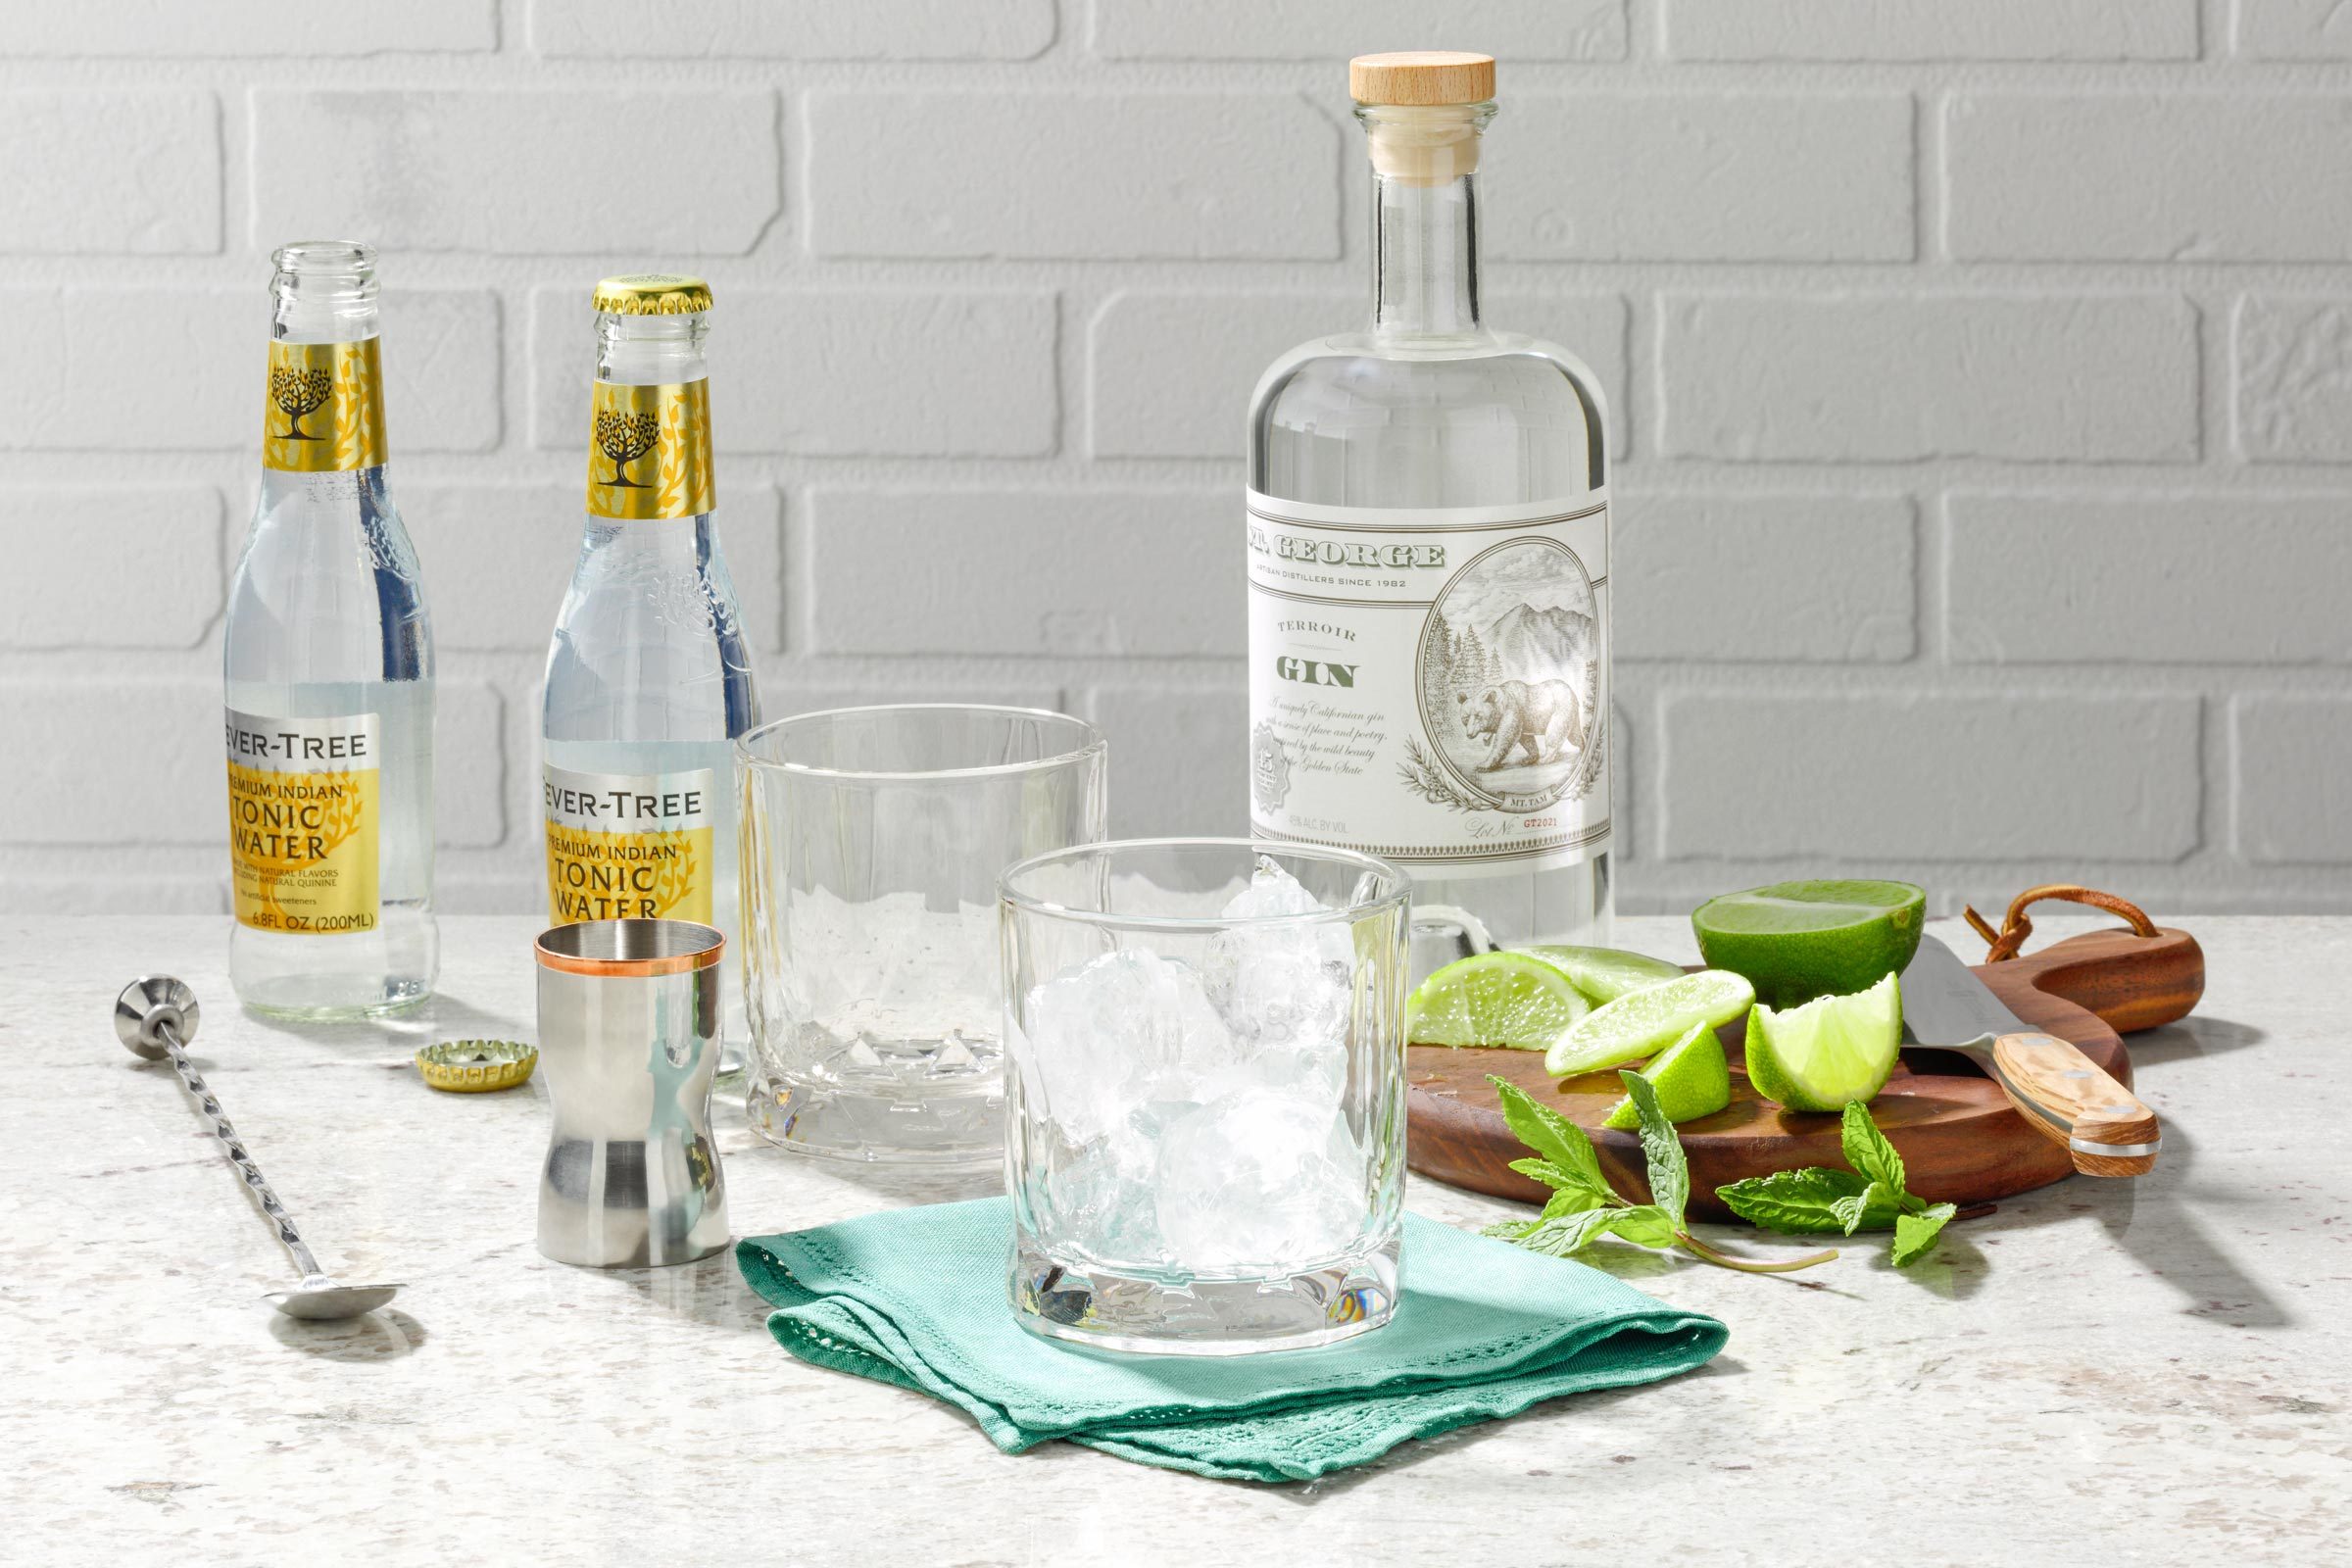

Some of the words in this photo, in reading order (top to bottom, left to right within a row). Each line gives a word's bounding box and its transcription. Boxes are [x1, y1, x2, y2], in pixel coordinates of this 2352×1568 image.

[1274, 534, 1446, 568] GEORGE
[1282, 571, 1335, 584] DISTILLERS
[1338, 578, 1372, 587] SINCE
[1277, 620, 1356, 642] TERROIR
[1276, 656, 1361, 688] GIN
[1307, 700, 1364, 720] Californian
[1366, 714, 1385, 726] gin
[1308, 723, 1332, 738] place
[1333, 727, 1354, 739] and
[1309, 741, 1323, 753] the
[1323, 745, 1344, 755] wild
[1345, 746, 1376, 762] beauty
[1300, 754, 1332, 773] Golden
[1334, 760, 1364, 775] State
[278, 784, 343, 800] INDIAN
[543, 776, 702, 818] EVER-TREE
[1528, 795, 1547, 807] TAM
[232, 795, 320, 830] TONIC
[1319, 819, 1332, 832] BY
[1465, 816, 1494, 839] Lot
[1523, 817, 1557, 828] GT2021
[233, 824, 328, 860] WATER
[548, 833, 601, 859] PREMIUM
[609, 845, 676, 860] INDIAN
[259, 866, 295, 878] NATURAL
[298, 868, 339, 878] FLAVORS
[259, 875, 295, 887] NATURAL
[297, 878, 337, 889] QUININE
[555, 858, 654, 893] TONIC
[271, 896, 318, 906] sweeteners
[555, 888, 657, 920] WATER
[253, 911, 281, 930] 6.8FL
[286, 915, 311, 930] OZ
[315, 913, 374, 934] (200ML)
